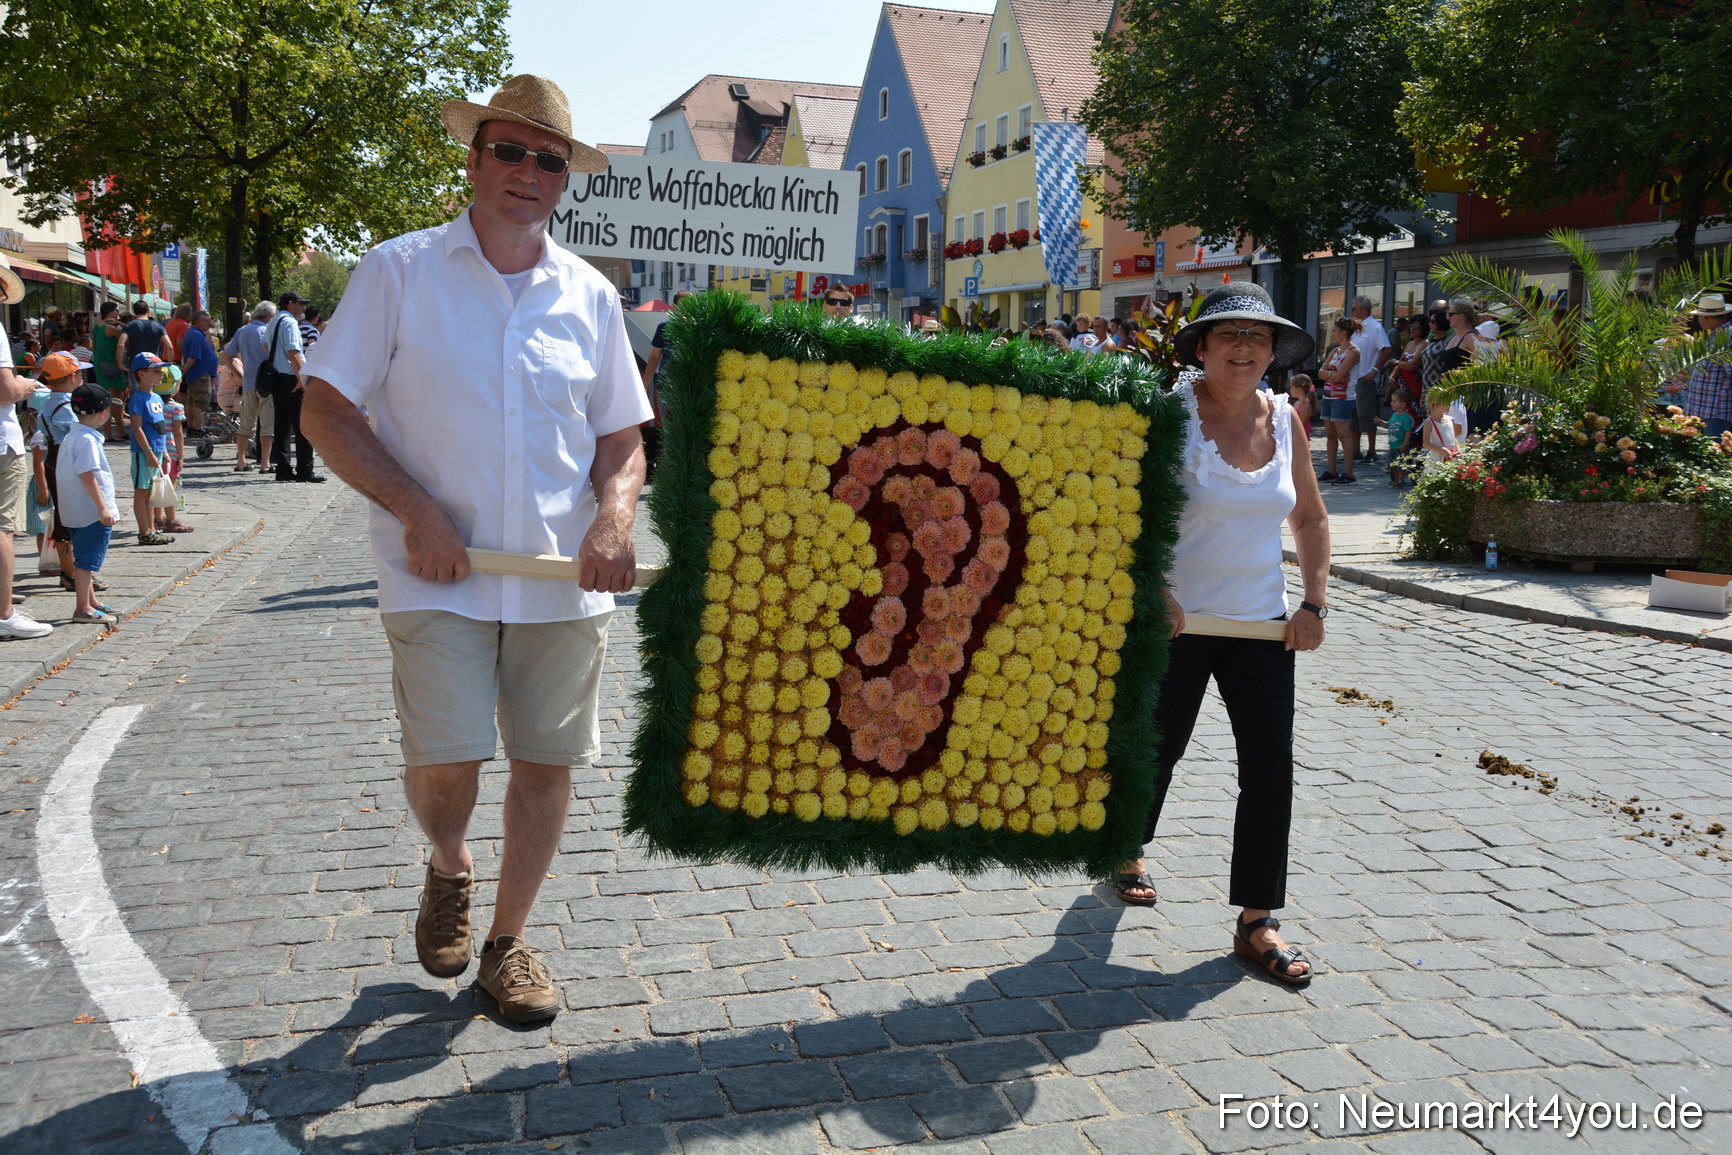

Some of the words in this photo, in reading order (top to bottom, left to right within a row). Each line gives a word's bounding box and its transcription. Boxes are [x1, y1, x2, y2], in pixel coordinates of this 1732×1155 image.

[572, 164, 642, 204] Jahre
[647, 165, 776, 211] Woffabecka
[781, 175, 839, 215] Kirch
[548, 208, 619, 248] Mini's
[629, 218, 735, 257] machen's
[742, 226, 825, 266] möglich
[1137, 257, 1151, 268] DER
